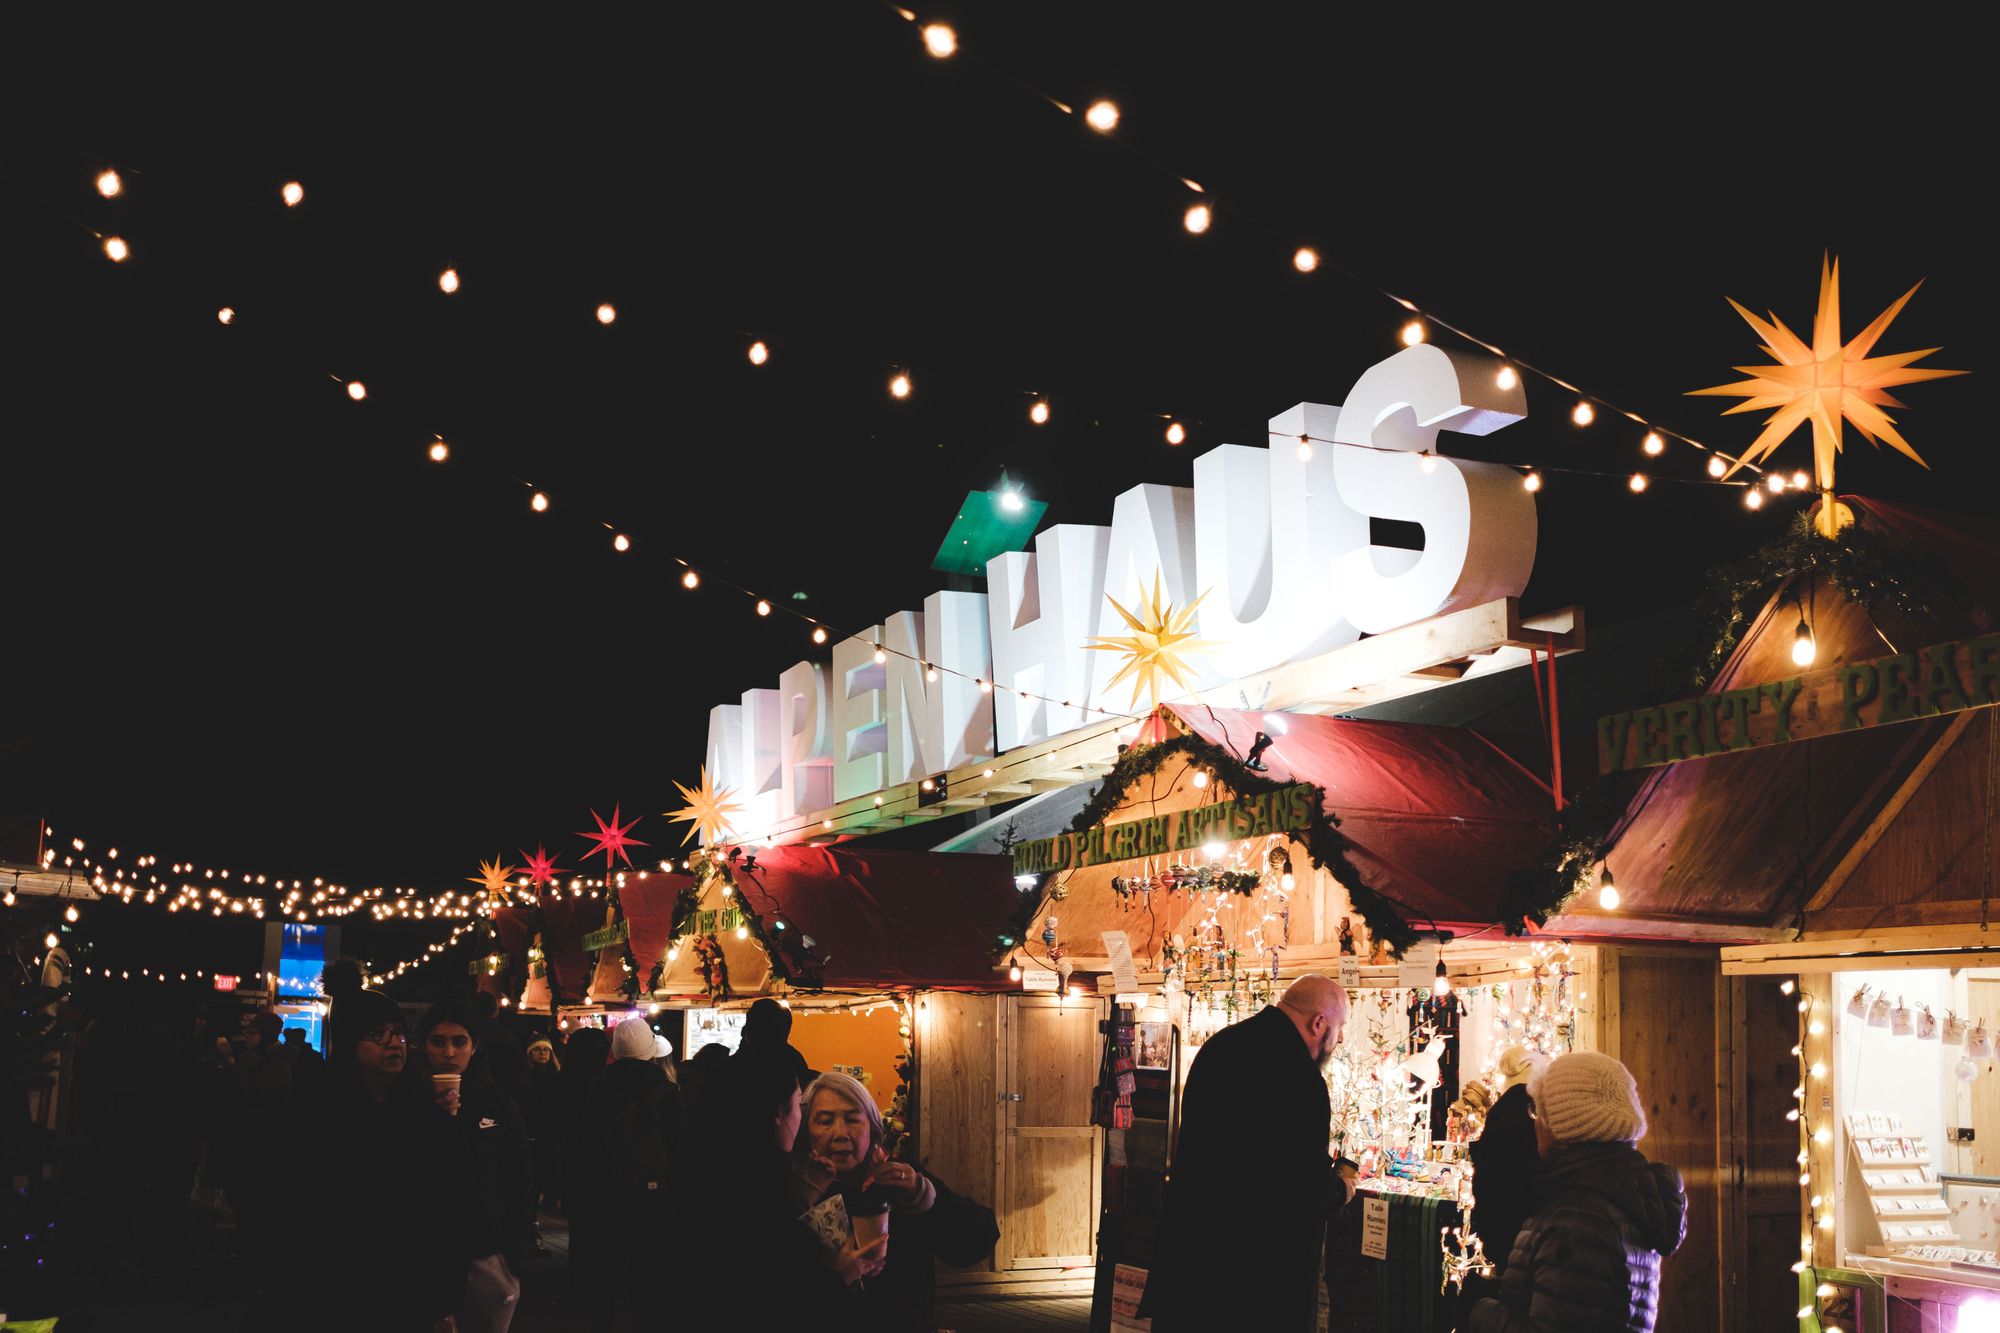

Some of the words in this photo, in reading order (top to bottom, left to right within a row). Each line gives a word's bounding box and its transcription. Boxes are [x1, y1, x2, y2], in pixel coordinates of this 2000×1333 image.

[699, 344, 1538, 847] ALPENHAUS
[1602, 680, 1801, 771] VERITY
[1013, 836, 1072, 875] WORLD
[1074, 818, 1169, 868] PILGRIM
[1175, 784, 1316, 851] ARTISANS
